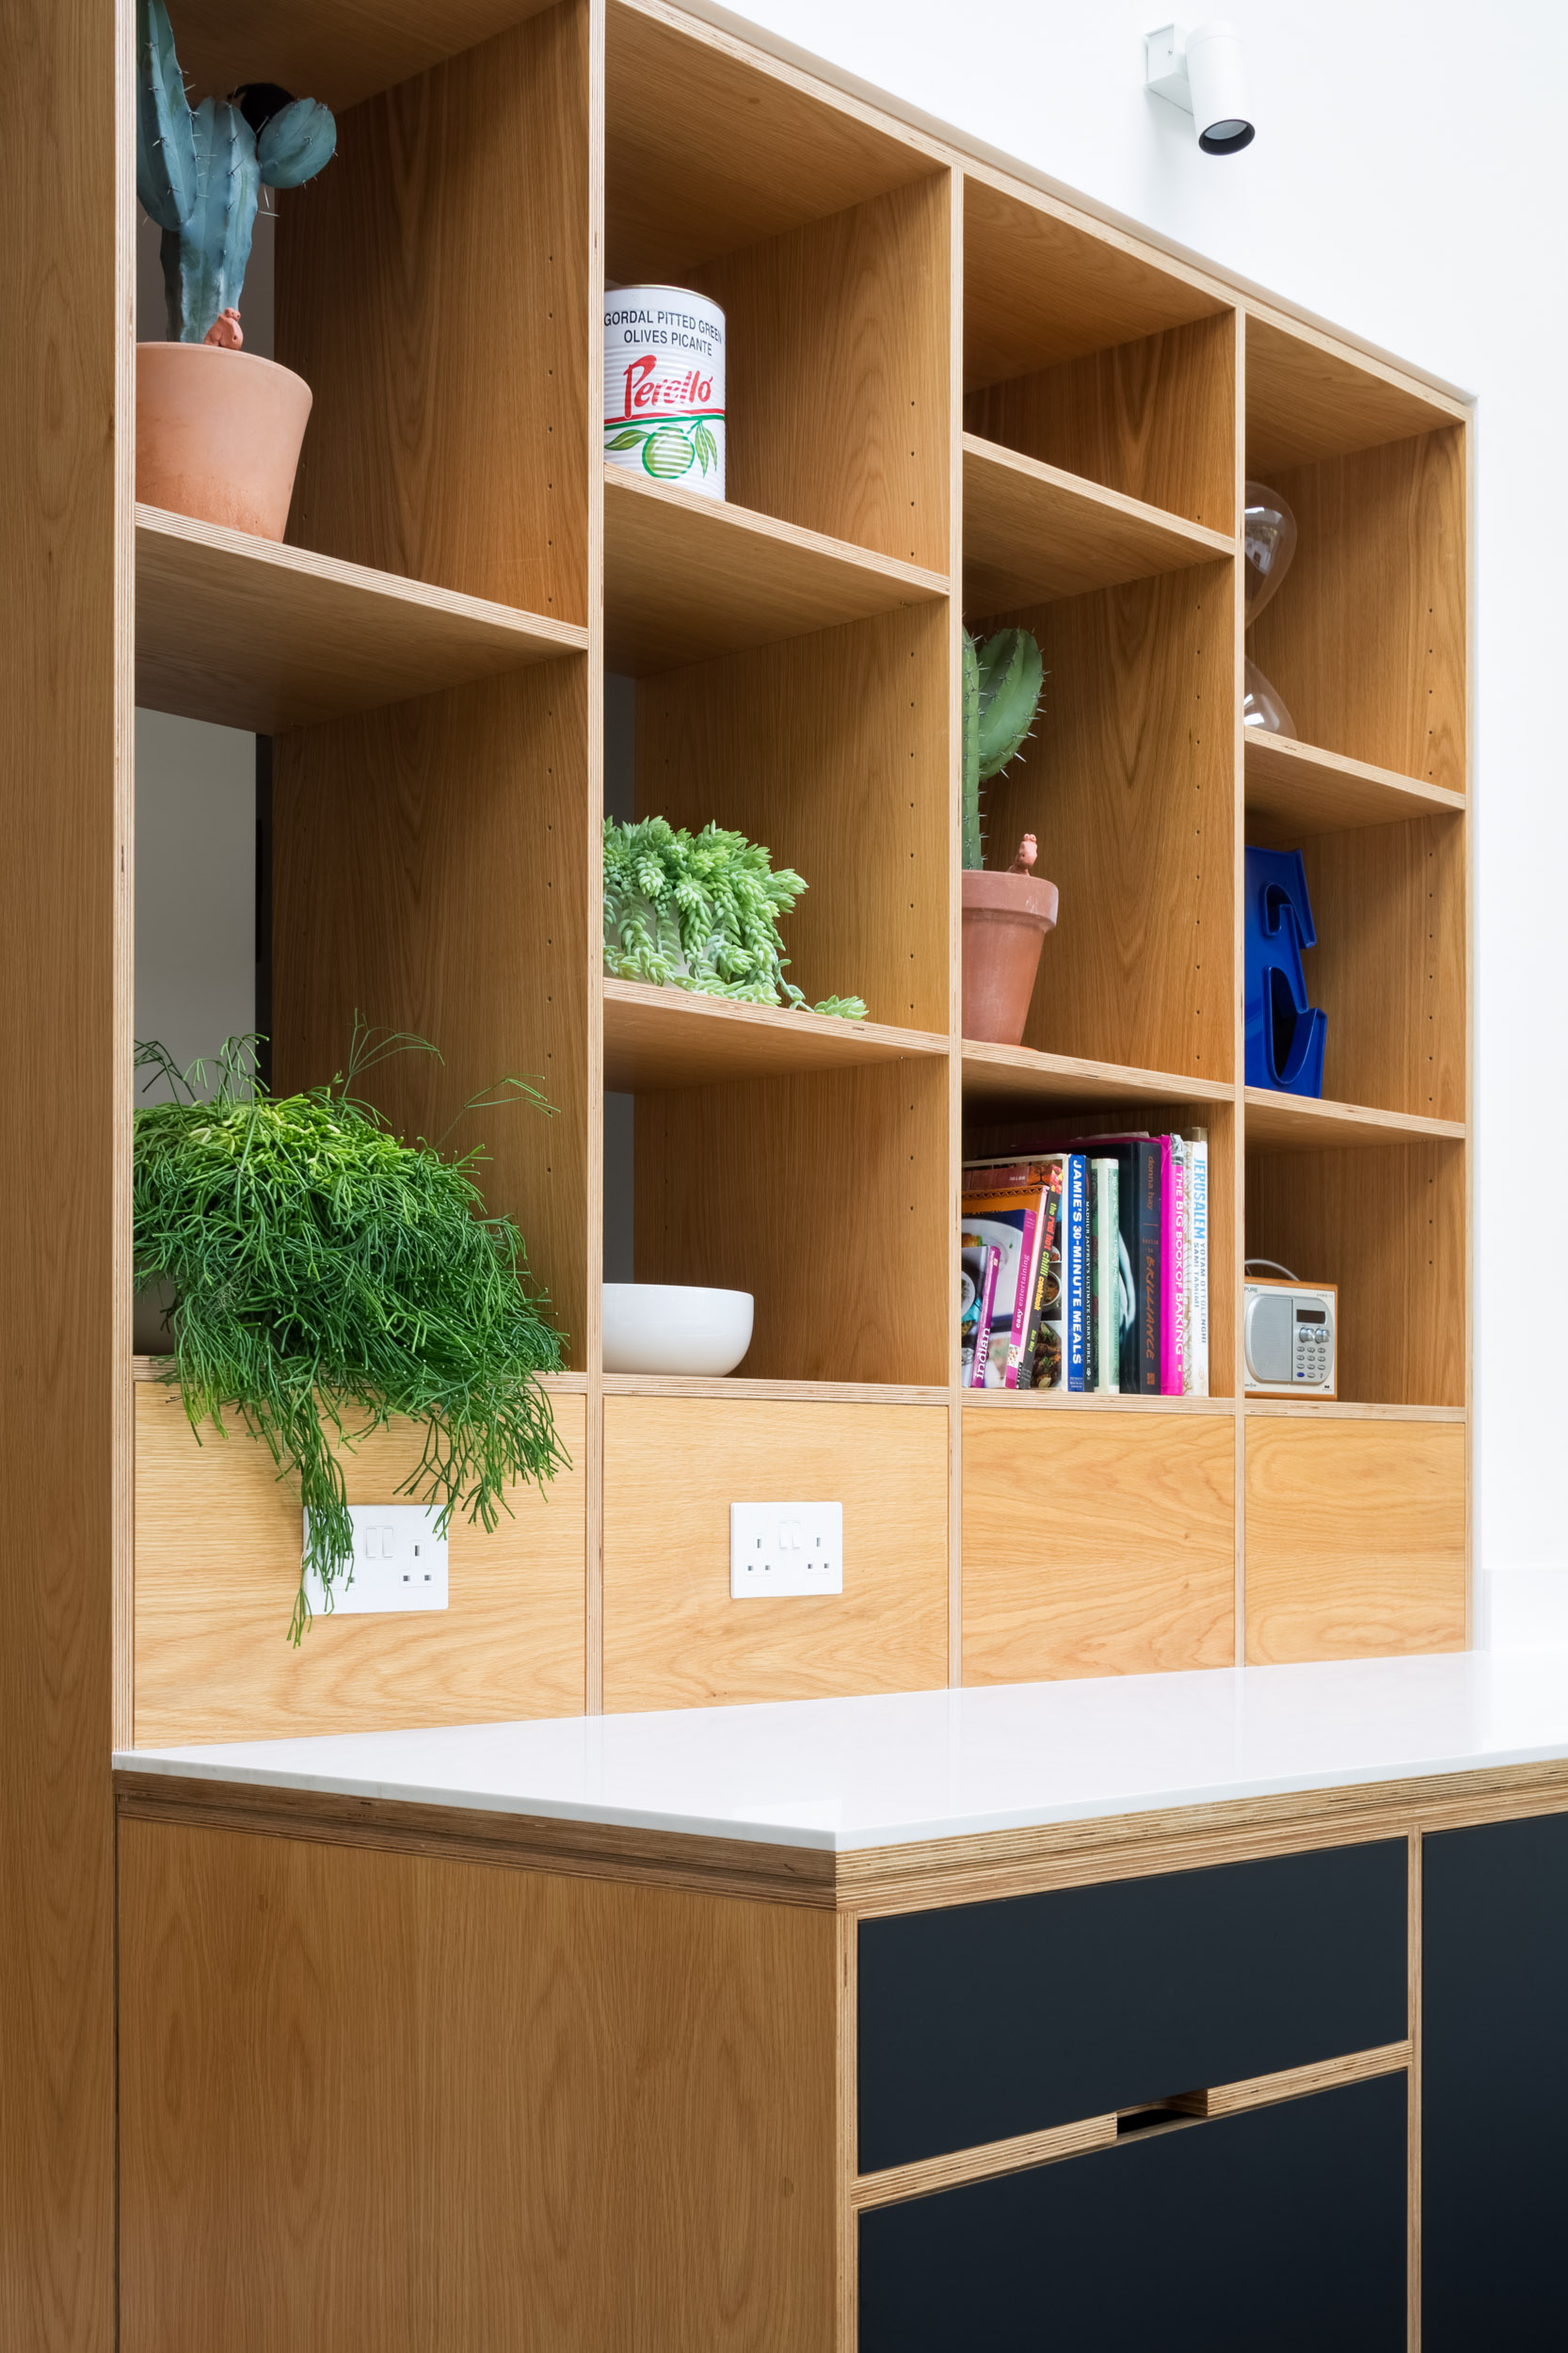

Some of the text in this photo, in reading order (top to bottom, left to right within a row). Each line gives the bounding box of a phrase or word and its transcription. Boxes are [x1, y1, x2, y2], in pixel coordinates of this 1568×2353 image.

[604, 311, 722, 344] GORDAL PITTED GREEN
[623, 329, 712, 357] OLIVES PICANTE
[1072, 1160, 1082, 1223] JAMIE'S
[1146, 1192, 1155, 1211] hay
[1194, 1158, 1206, 1239] JERUSALEM
[1033, 1202, 1057, 1311] the red hot chilli cookbook
[1072, 1225, 1082, 1306] 30-MINUTE
[1176, 1272, 1183, 1289] OF
[1016, 1254, 1031, 1329] easy entertaining
[1145, 1255, 1156, 1361] BRILLIANCE
[975, 1327, 992, 1381] indian
[1071, 1310, 1082, 1365] MEALS
